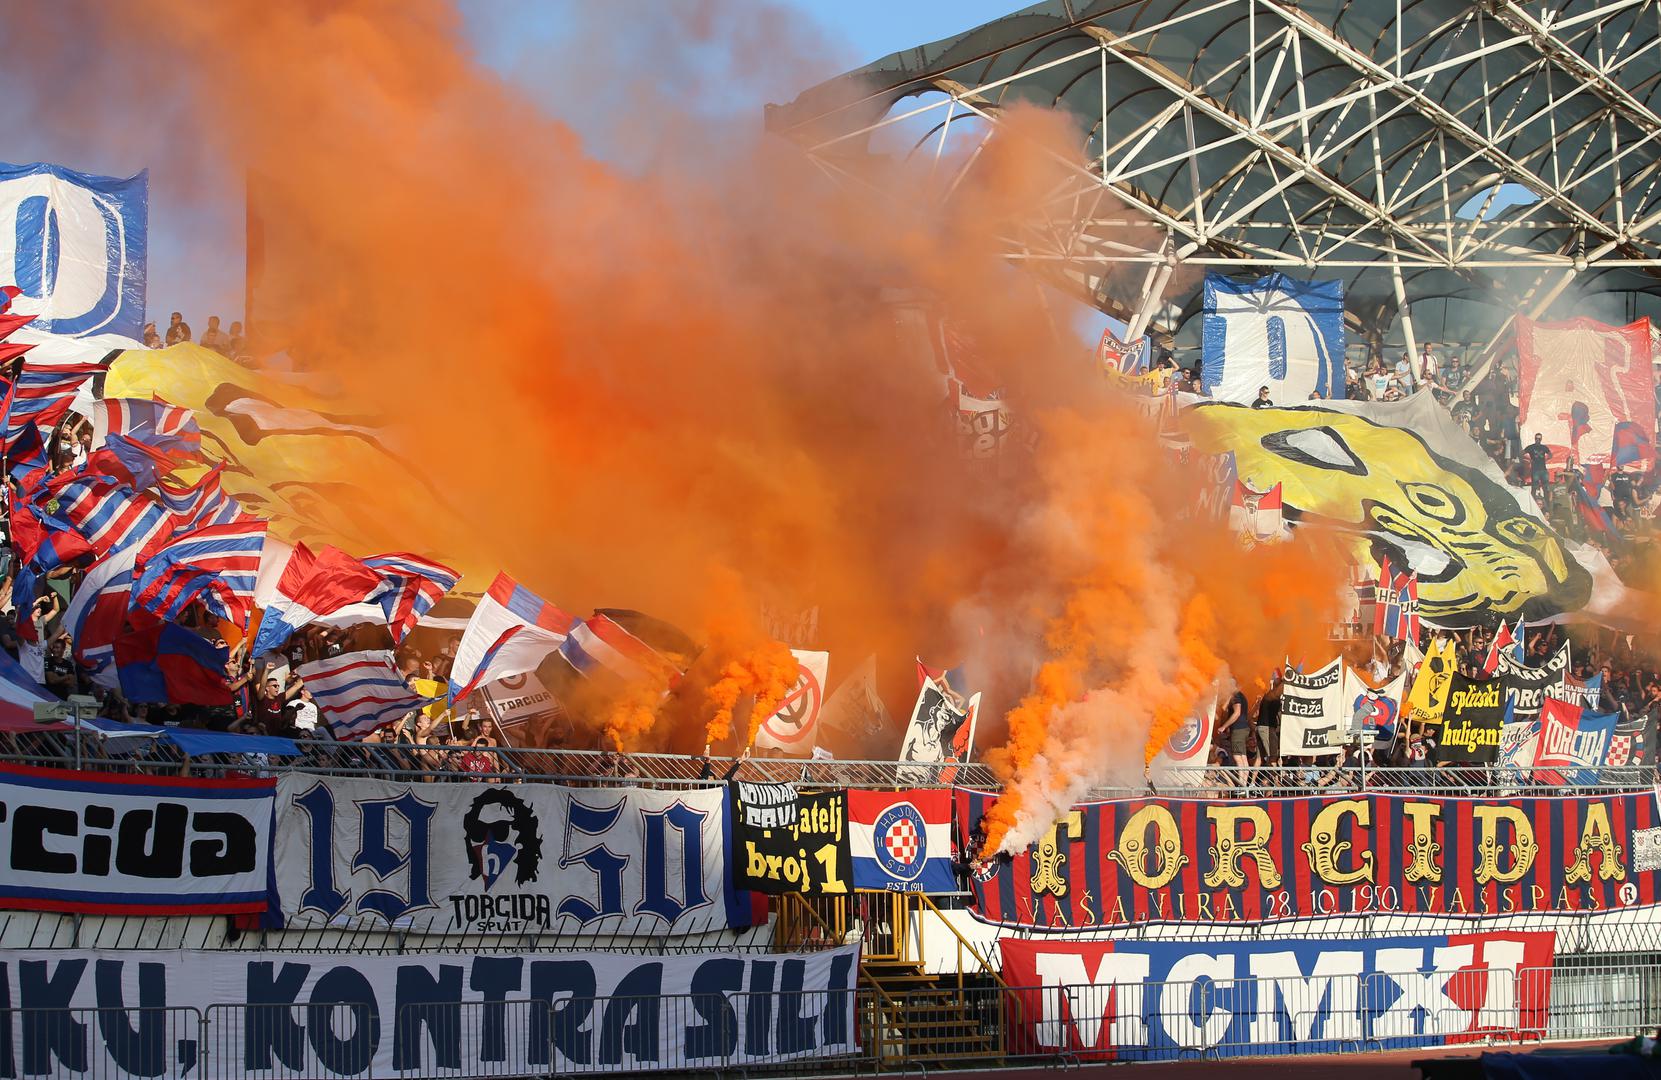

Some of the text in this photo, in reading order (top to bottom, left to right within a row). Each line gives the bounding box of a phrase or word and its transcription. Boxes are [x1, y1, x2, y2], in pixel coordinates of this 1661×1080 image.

[1284, 666, 1310, 686] Oni
[498, 691, 552, 711] TORCIDA
[1288, 700, 1321, 715] traže
[1451, 683, 1500, 715] splitski
[1541, 711, 1607, 767] TORCIDA
[880, 806, 921, 829] HAJDUK
[0, 802, 256, 879] cida
[292, 780, 716, 927] 19 50
[1031, 799, 1626, 897] TORCIDA
[746, 841, 848, 893] broj 1
[886, 859, 921, 877] SPLIT
[910, 882, 924, 892] 1911
[449, 894, 550, 929] TORCIDA
[1150, 891, 1241, 921] VIRA
[476, 921, 522, 932] SPLIT
[1036, 941, 1527, 1048] MCMXI
